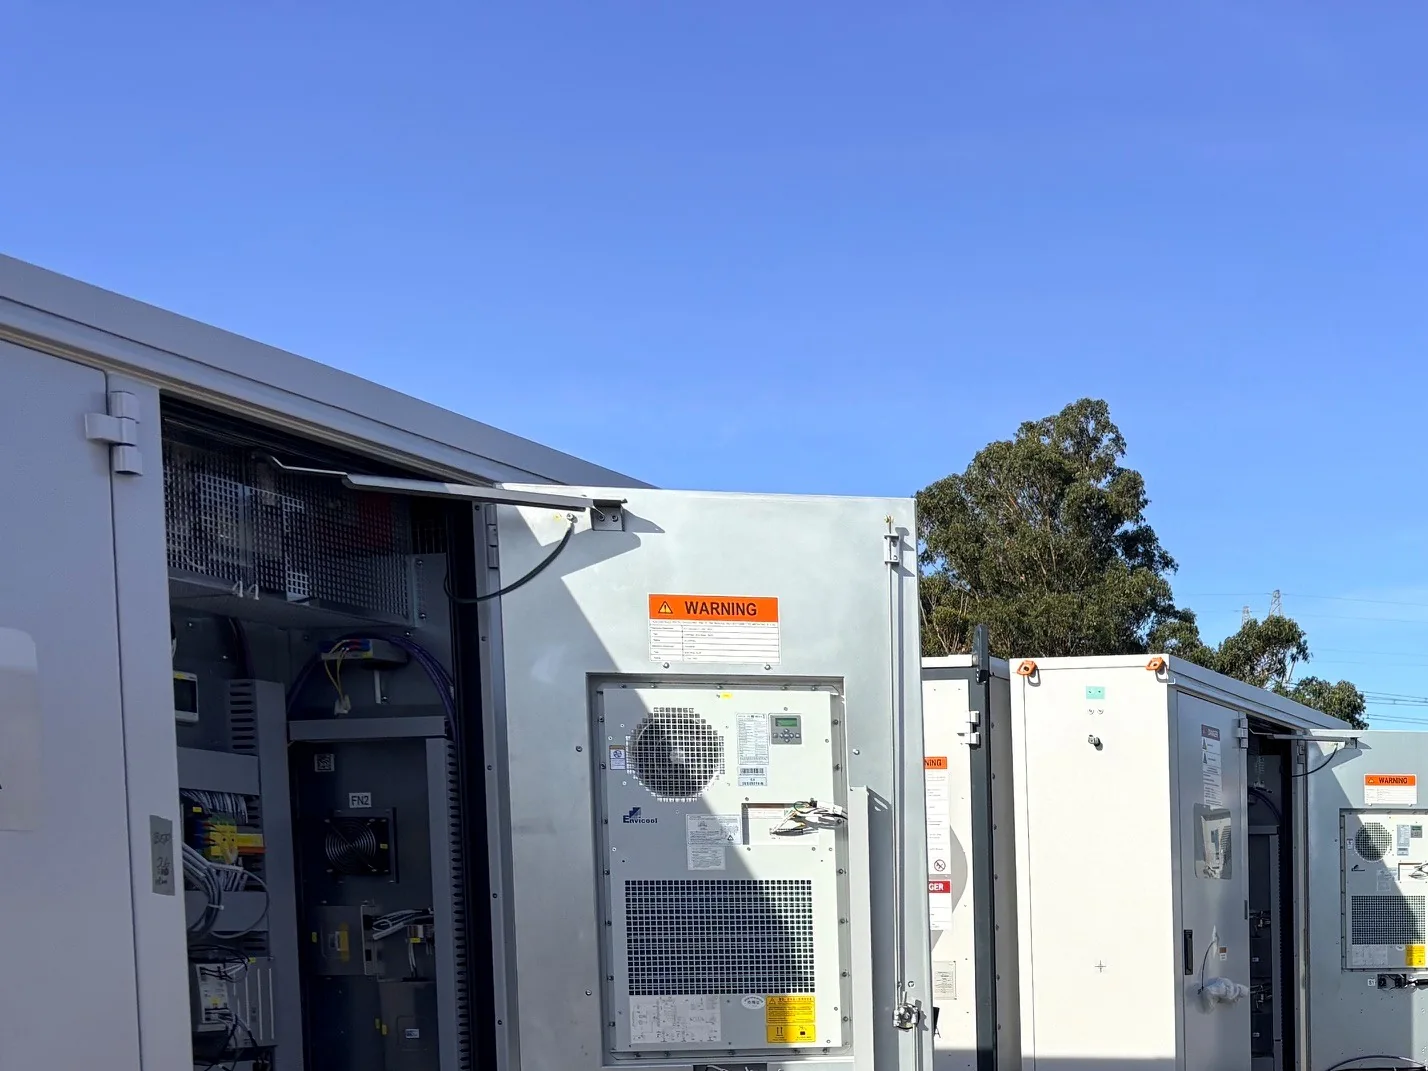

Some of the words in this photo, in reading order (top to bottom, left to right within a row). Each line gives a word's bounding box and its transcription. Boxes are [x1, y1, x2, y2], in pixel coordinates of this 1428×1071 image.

[684, 600, 757, 617] WARNING
[925, 758, 942, 767] NING
[1378, 776, 1408, 784] WARNING
[351, 795, 369, 806] FN2
[622, 814, 658, 824] Envicool
[929, 882, 944, 891] GER
